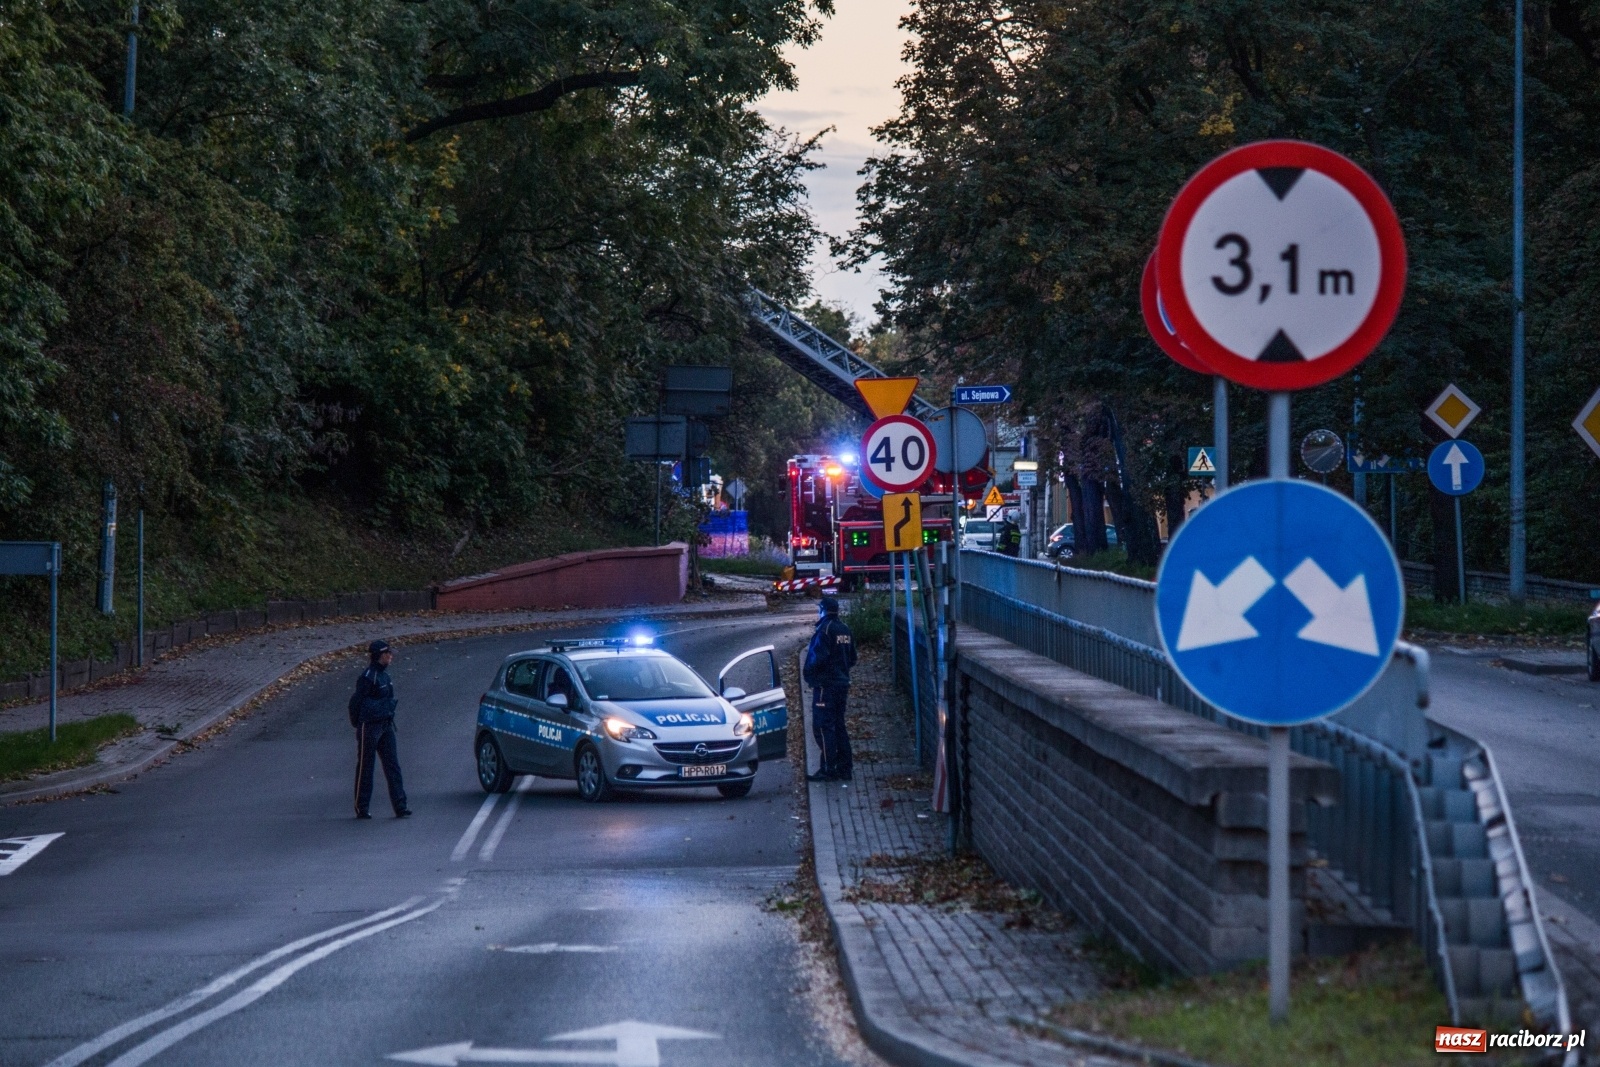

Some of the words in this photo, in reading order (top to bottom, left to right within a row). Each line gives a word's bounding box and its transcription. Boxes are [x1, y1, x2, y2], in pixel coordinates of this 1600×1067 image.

[1210, 232, 1299, 305] 3,1
[1318, 269, 1355, 295] m
[961, 390, 970, 400] ul.
[971, 390, 999, 401] Sejmowa
[870, 435, 925, 472] 40
[655, 713, 721, 724] POLICJA
[538, 724, 562, 742] POLICJA
